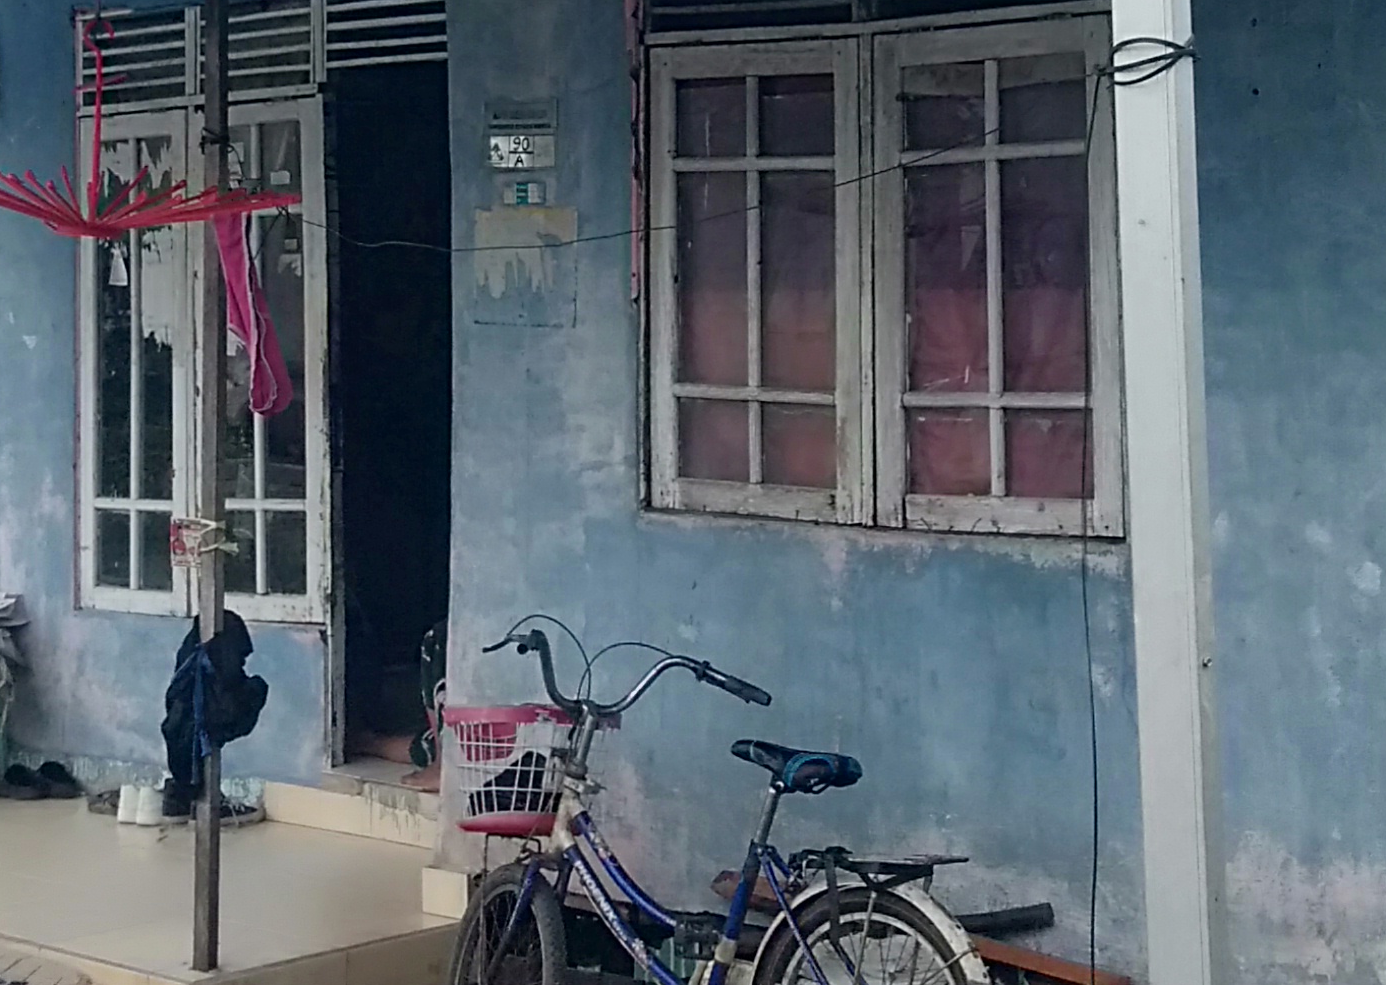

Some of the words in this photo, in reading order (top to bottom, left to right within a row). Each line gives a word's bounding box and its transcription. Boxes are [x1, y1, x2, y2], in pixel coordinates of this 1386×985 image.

[512, 136, 530, 151] 90
[514, 155, 525, 167] A
[573, 860, 617, 922] PHOENIX
